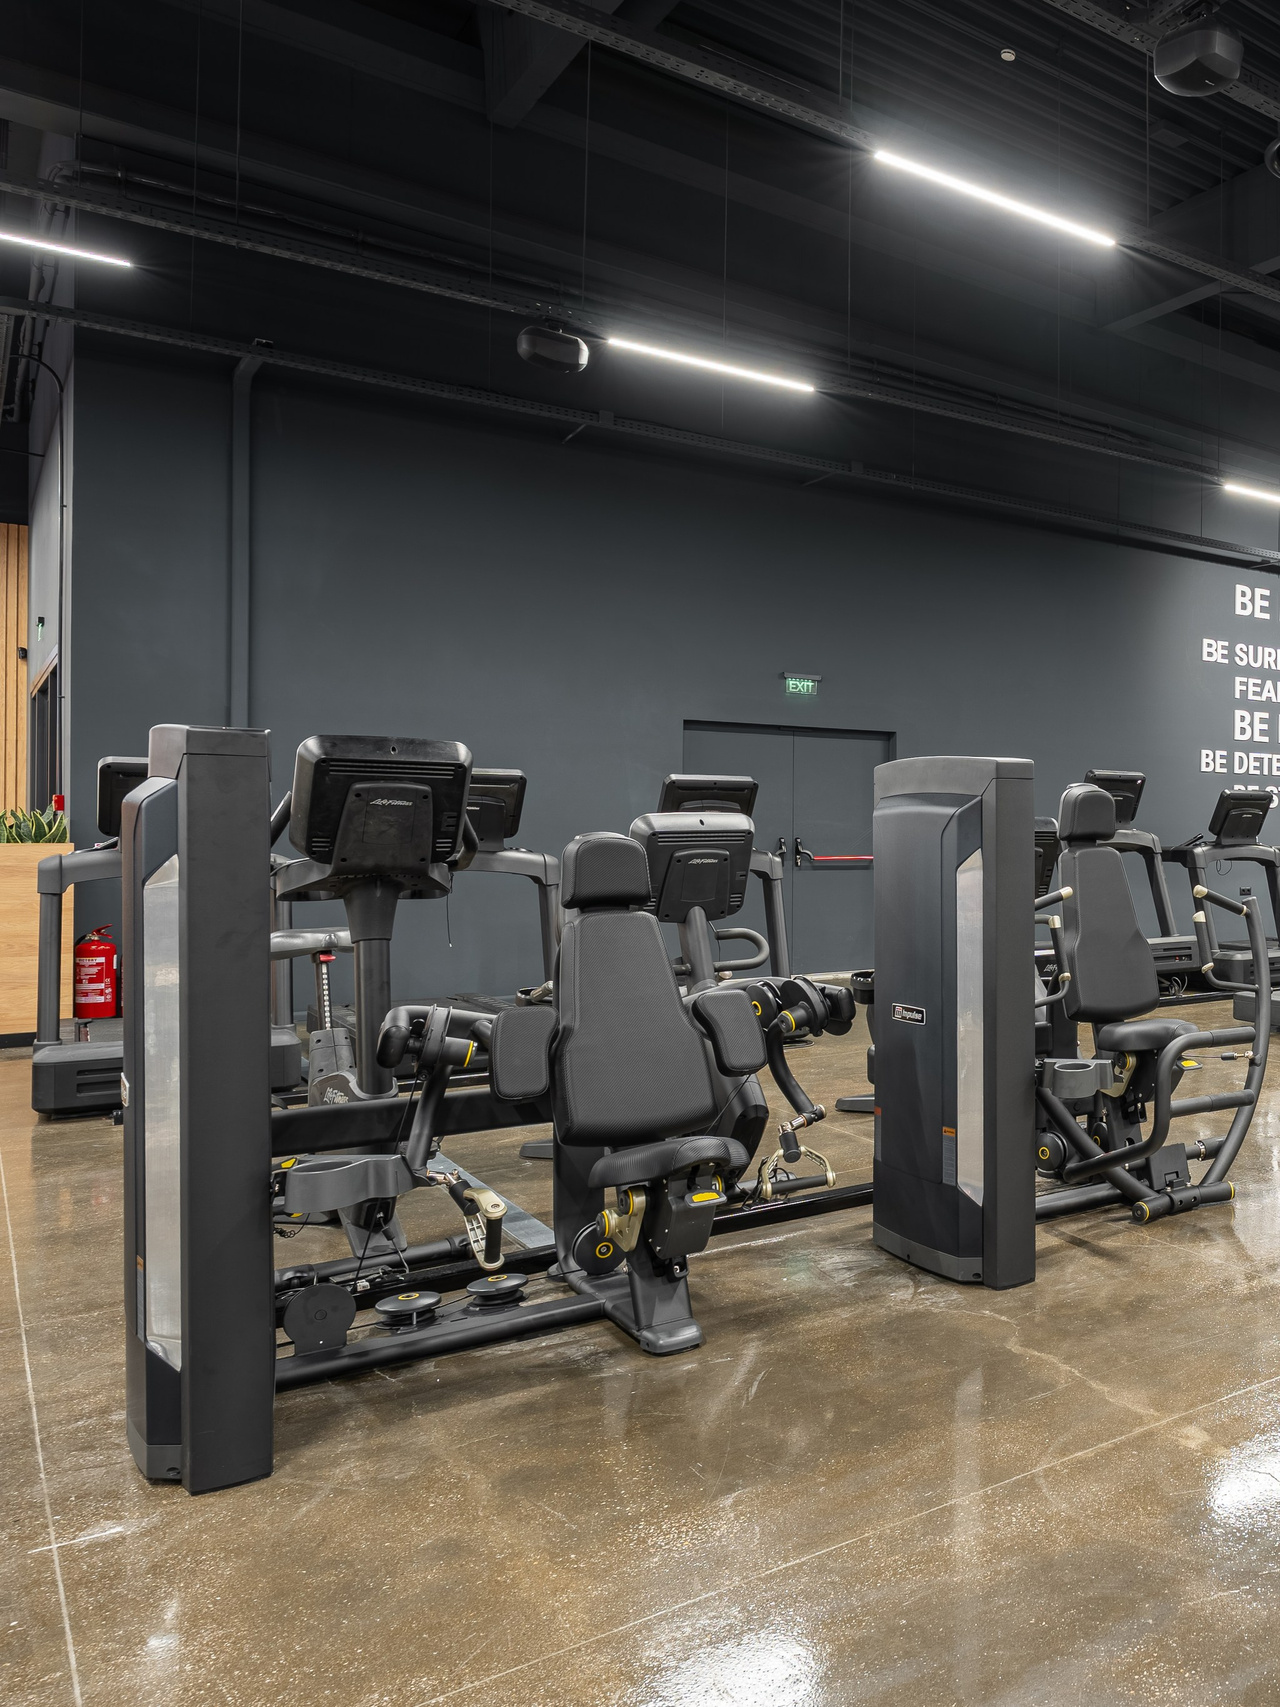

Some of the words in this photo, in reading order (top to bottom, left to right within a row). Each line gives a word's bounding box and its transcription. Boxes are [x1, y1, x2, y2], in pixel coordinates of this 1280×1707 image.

[1234, 584, 1270, 620] BE
[1202, 638, 1229, 664] BE
[790, 681, 814, 692] EXIT
[1234, 710, 1270, 743] BE
[1200, 749, 1227, 773] BE
[903, 1010, 922, 1020] Impulse
